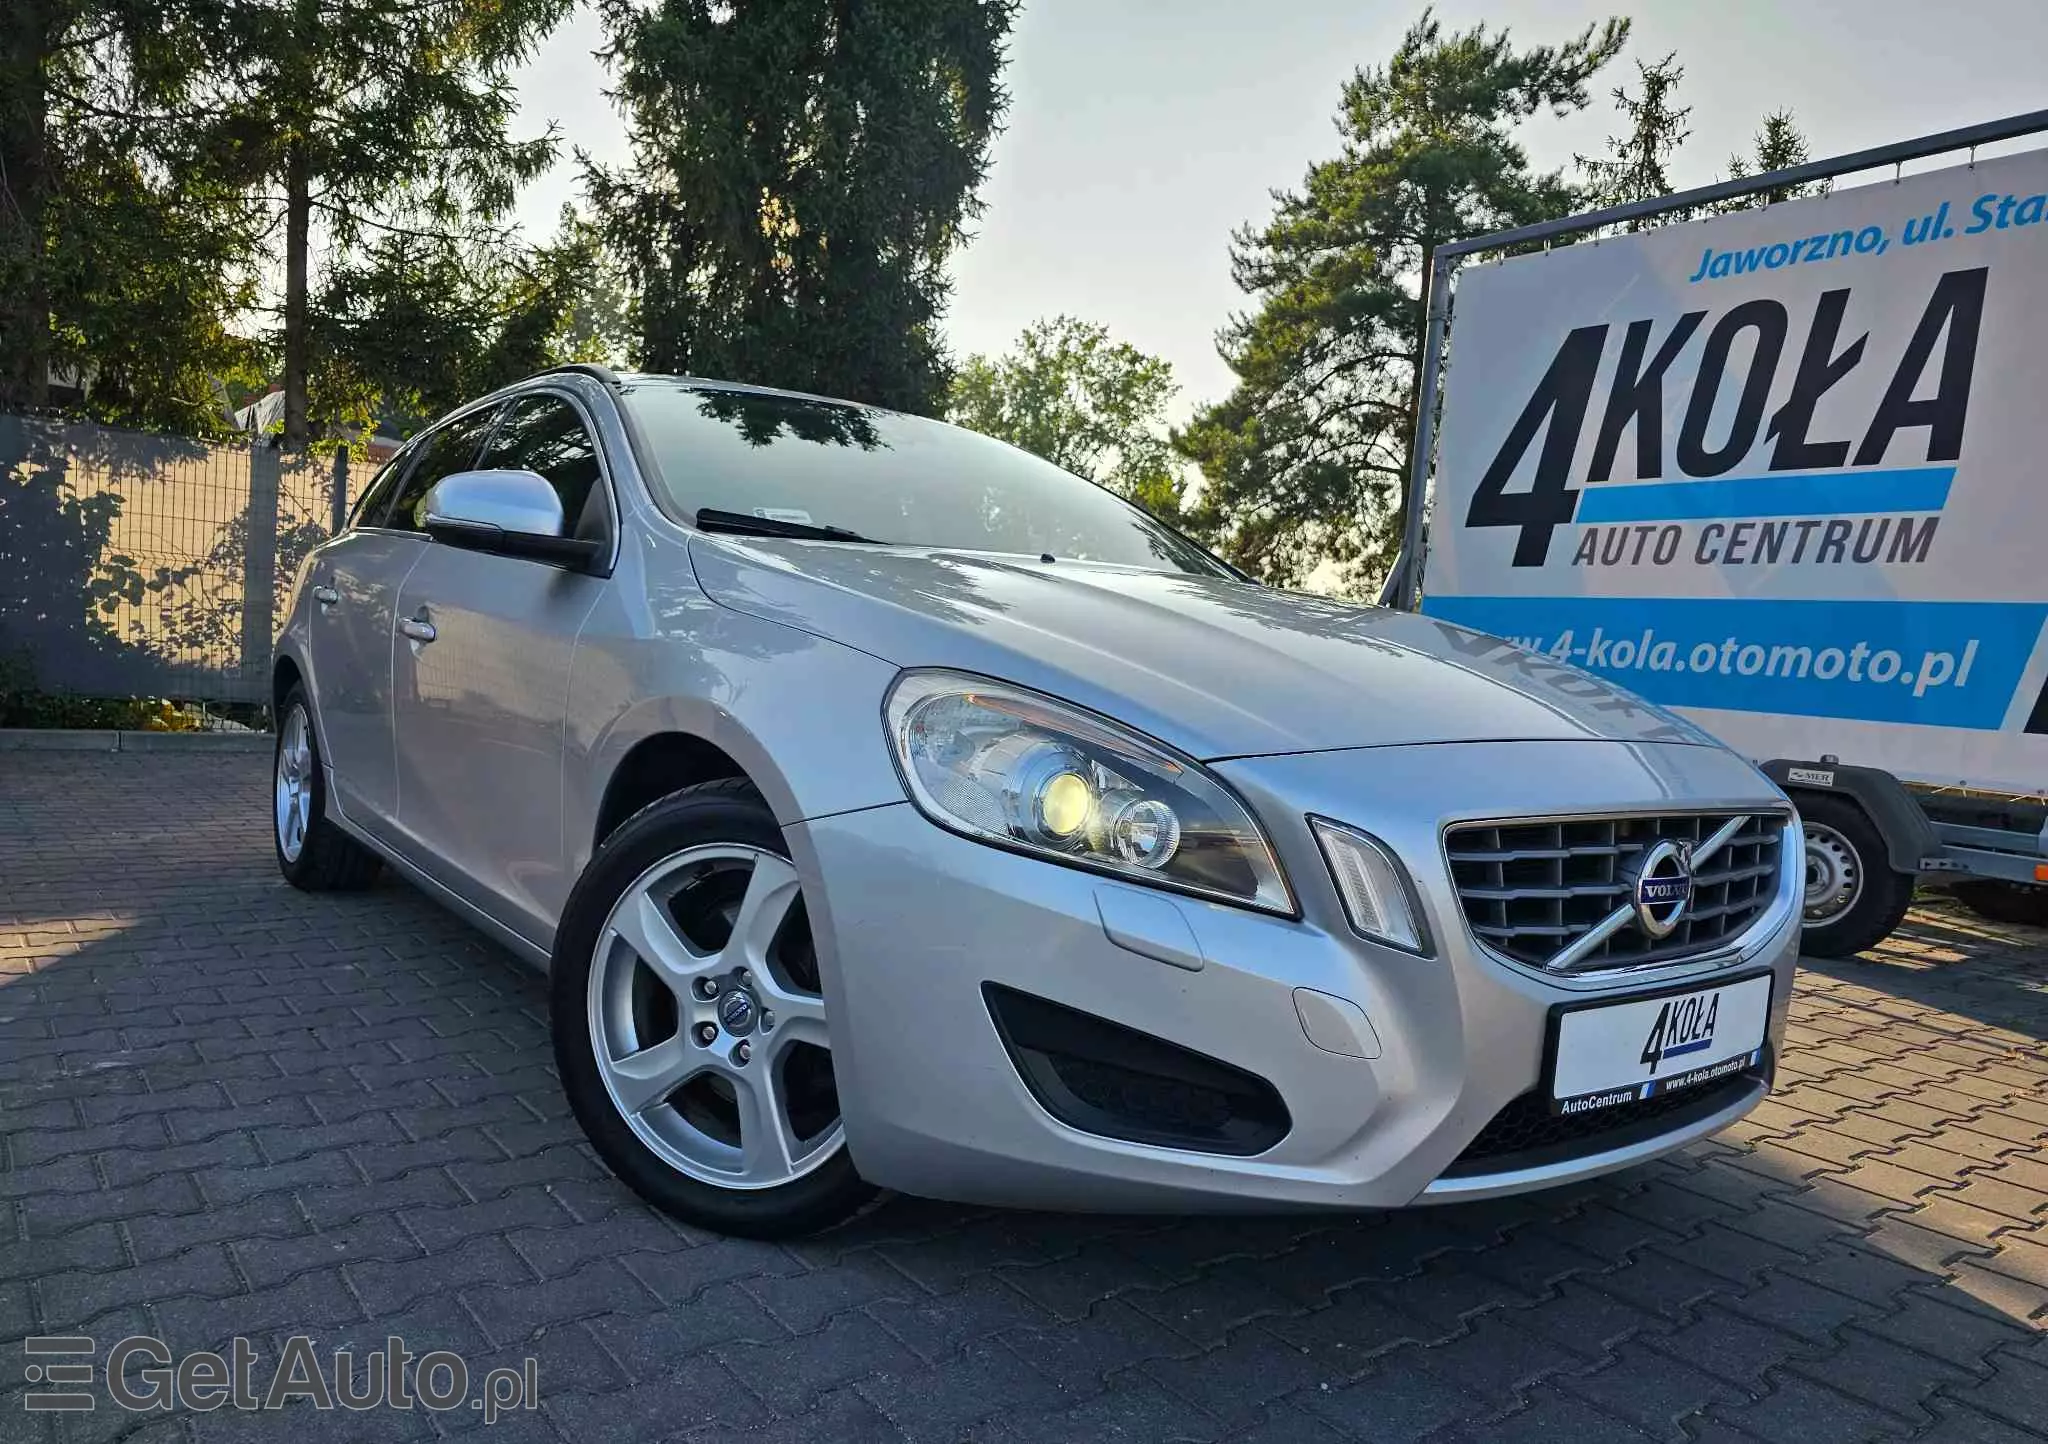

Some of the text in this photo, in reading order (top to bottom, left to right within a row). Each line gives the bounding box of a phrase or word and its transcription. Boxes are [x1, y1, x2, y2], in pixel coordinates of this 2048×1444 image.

[1690, 194, 2048, 282] Jaworzno, ul. Sta
[1572, 517, 1940, 566] AUTO CENTRUM
[1645, 884, 1688, 898] VOLVO
[1561, 1056, 1746, 1115] AutoCentrum www.4-kola.otomoto.pl
